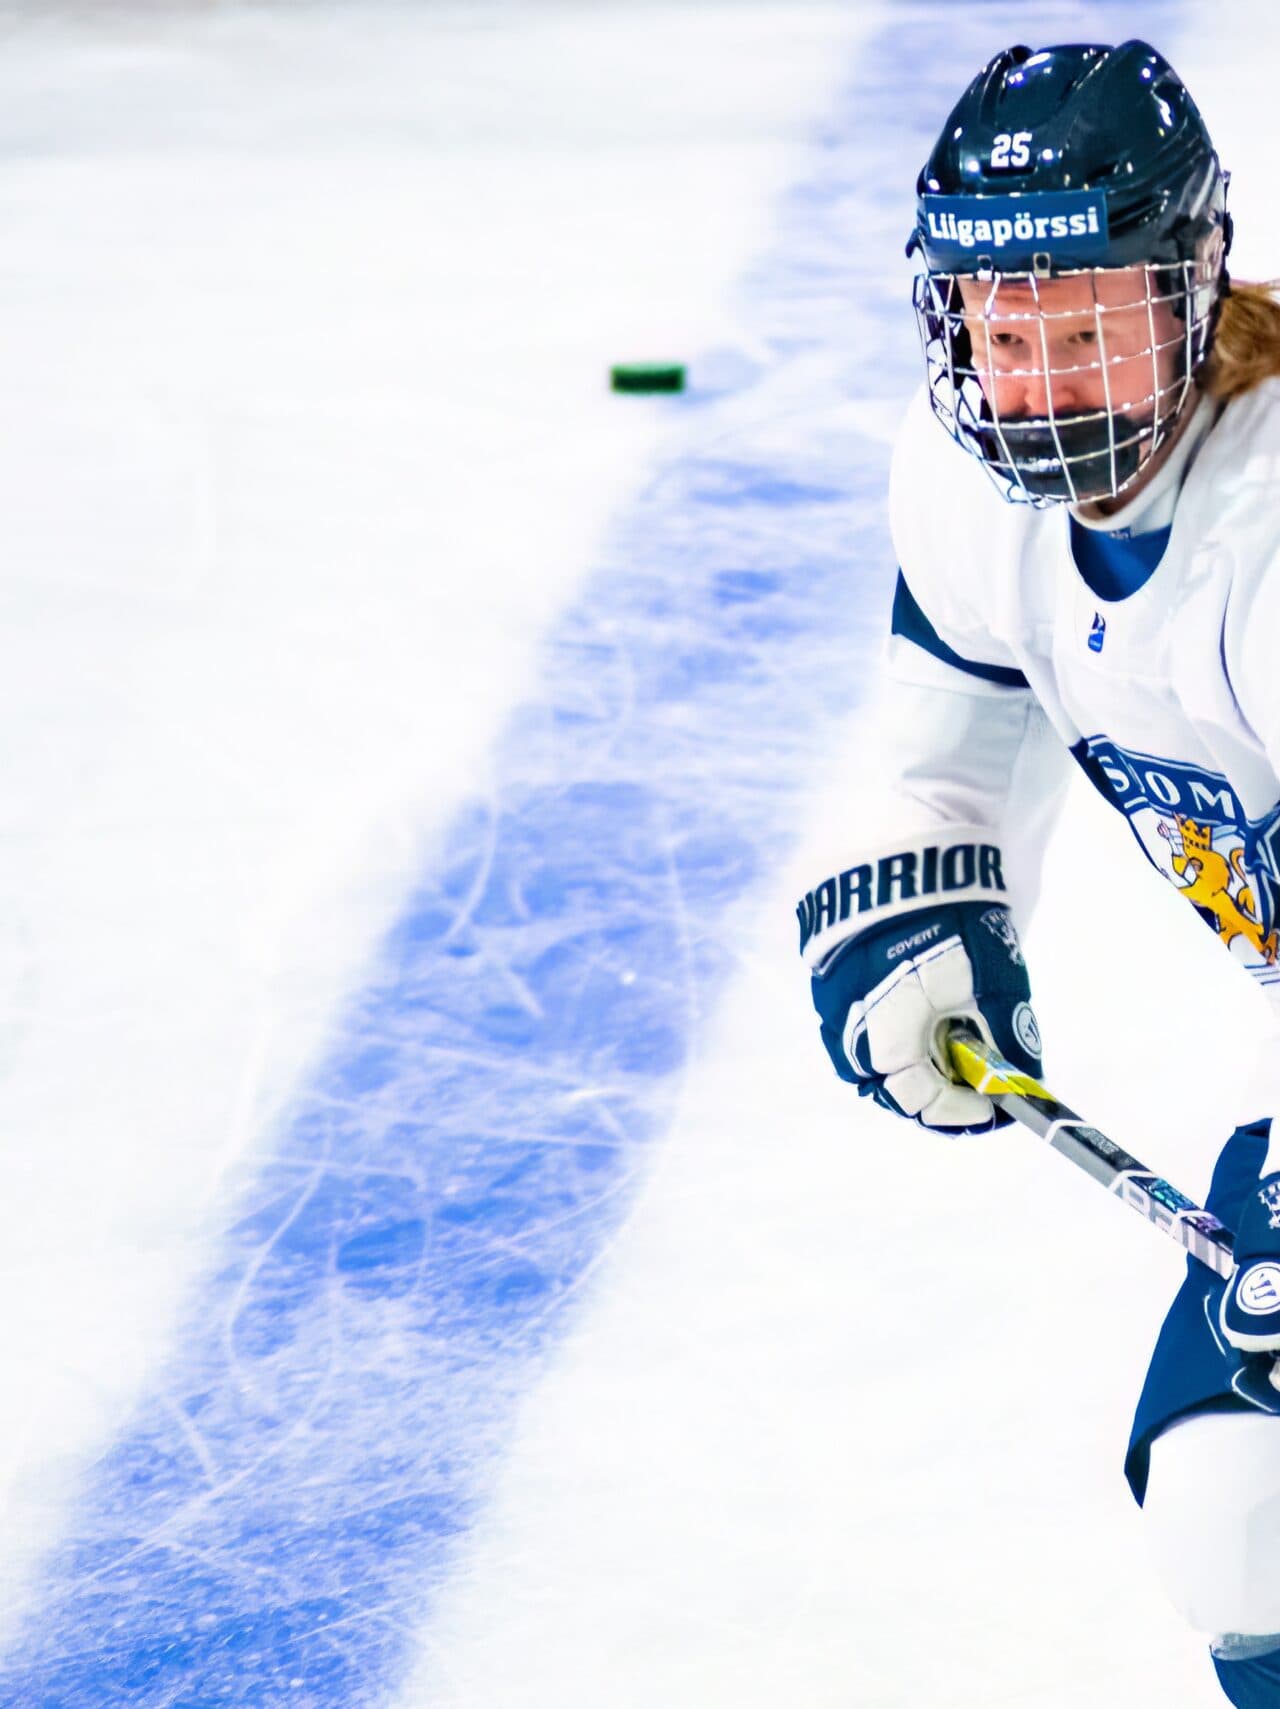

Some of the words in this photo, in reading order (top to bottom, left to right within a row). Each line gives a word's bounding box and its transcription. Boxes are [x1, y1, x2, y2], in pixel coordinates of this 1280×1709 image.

[990, 131, 1033, 169] 25
[926, 206, 1099, 247] Liigapörssi
[796, 844, 1007, 958] WARRIOR
[885, 923, 942, 960] COVERT
